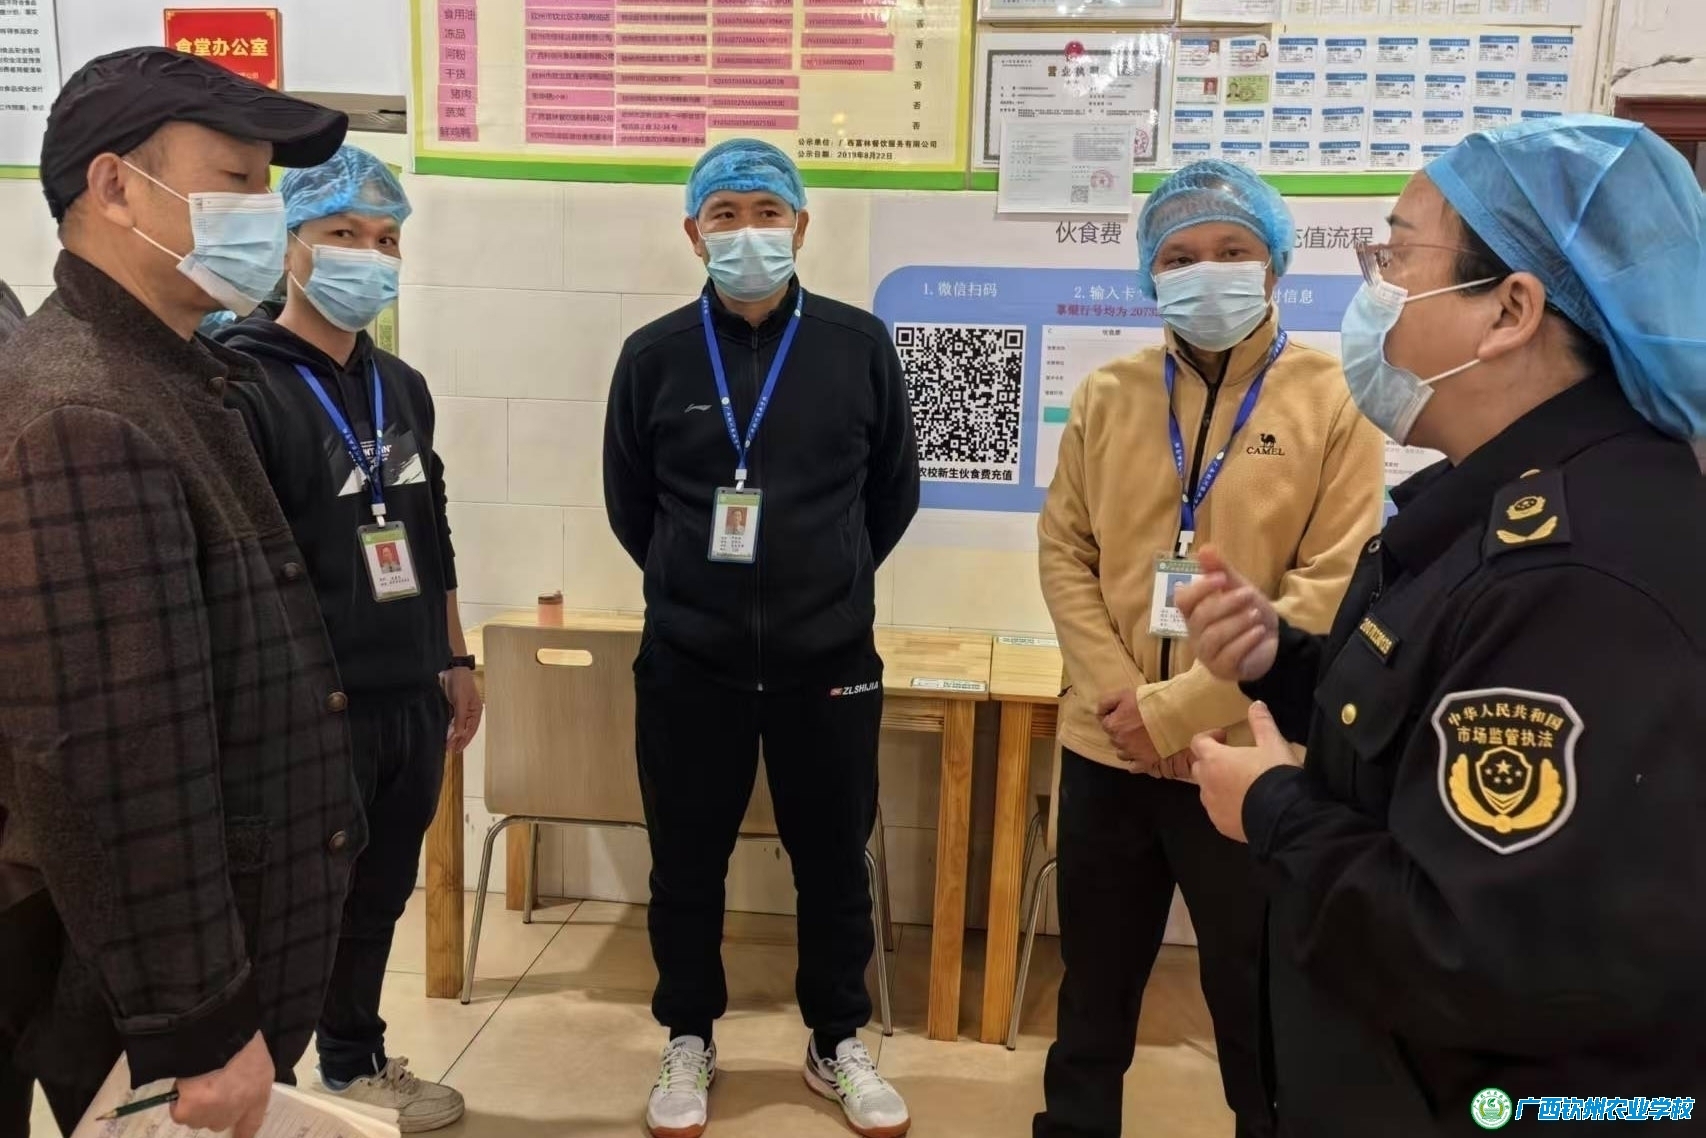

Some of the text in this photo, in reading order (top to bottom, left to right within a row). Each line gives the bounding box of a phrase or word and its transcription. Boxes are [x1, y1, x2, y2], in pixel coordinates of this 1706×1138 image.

[175, 37, 269, 57] 食堂办公室
[450, 88, 472, 100] 猪肉
[1056, 220, 1121, 244] 伙食费
[1247, 446, 1285, 456] CAMEL
[919, 467, 1013, 481] 农校新生伙食费充值
[1448, 703, 1564, 730] 中华人民共和国
[1457, 726, 1554, 749] 市场监管执法
